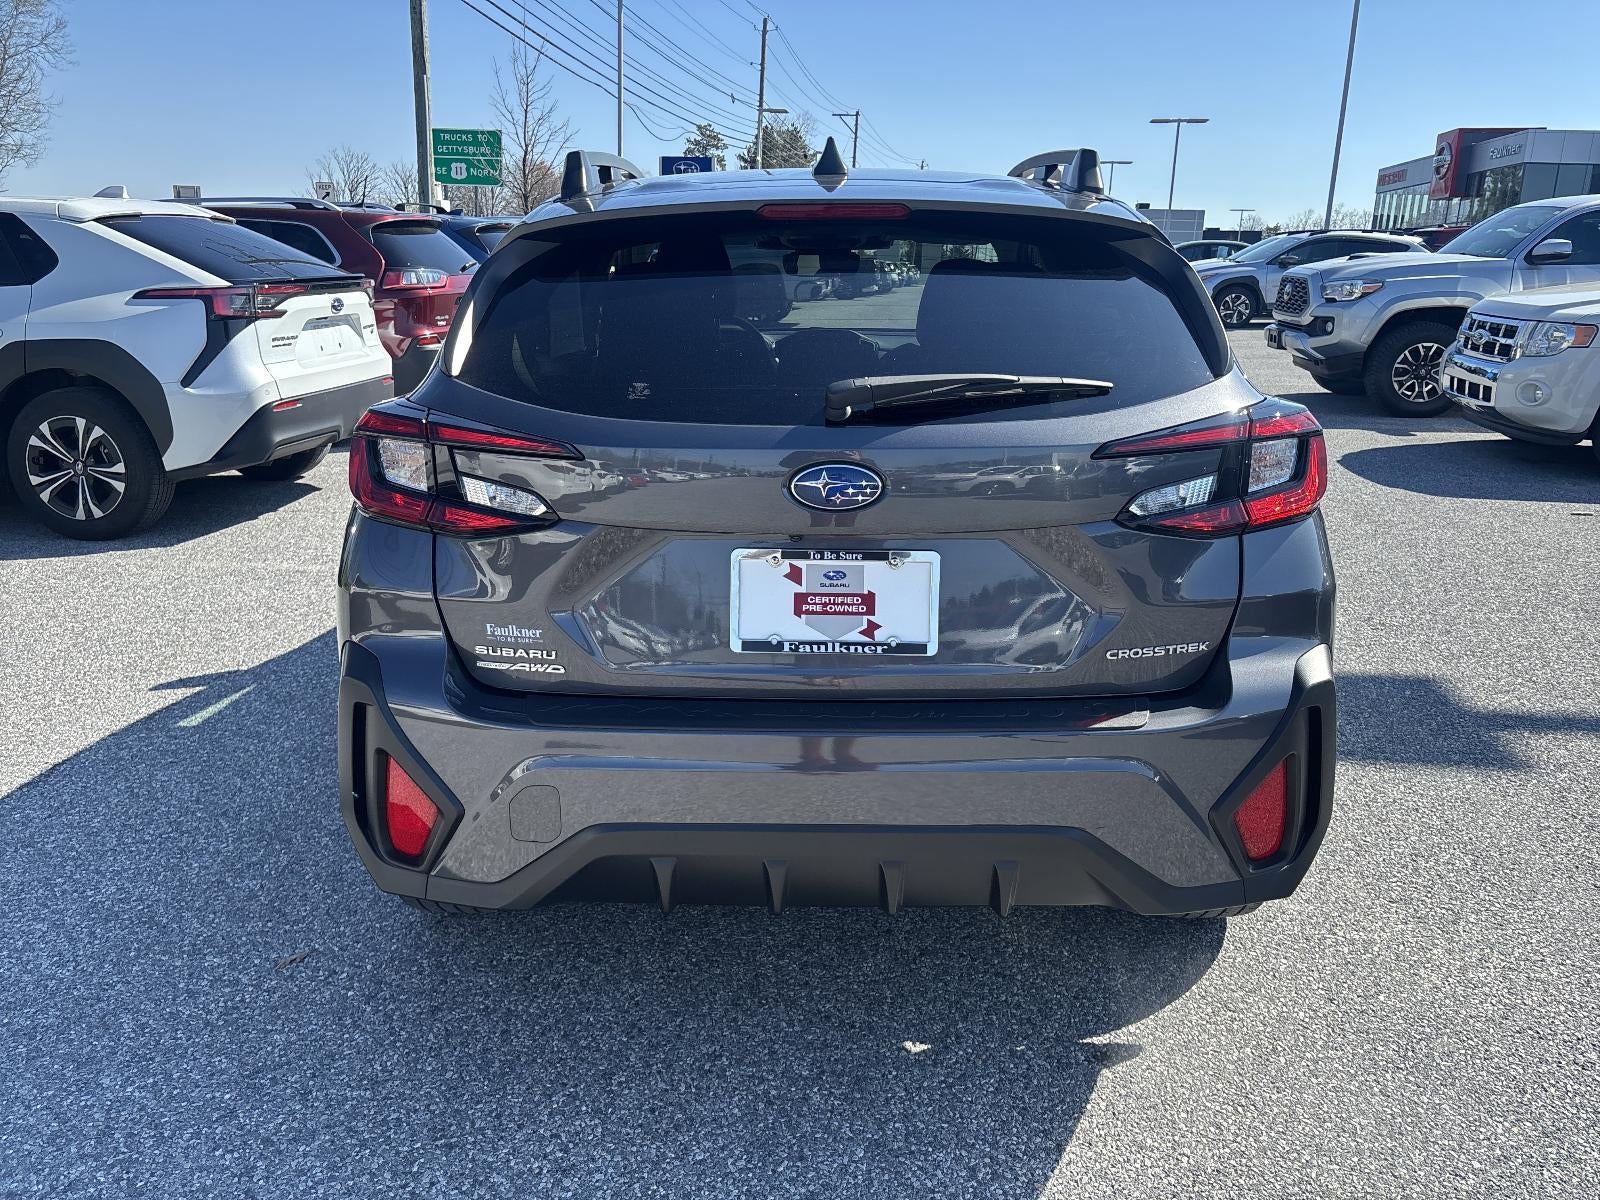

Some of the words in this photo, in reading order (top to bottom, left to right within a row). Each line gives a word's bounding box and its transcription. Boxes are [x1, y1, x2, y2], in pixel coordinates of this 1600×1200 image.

[440, 133, 473, 141] TRUCKS
[477, 134, 488, 142] TO
[437, 145, 491, 154] GETTYSBURG
[435, 167, 447, 175] SE
[454, 166, 463, 176] 11
[808, 551, 822, 560] To
[824, 551, 837, 560] Be
[839, 551, 863, 561] Sure
[807, 596, 862, 604] CERTIFIED
[802, 604, 867, 613] PRE-OWNED
[485, 623, 543, 638] Faulkner
[474, 645, 557, 660] SUBARU
[782, 641, 888, 654] Faulkner
[1105, 641, 1210, 660] CROSSTREK
[509, 662, 567, 674] AWD
